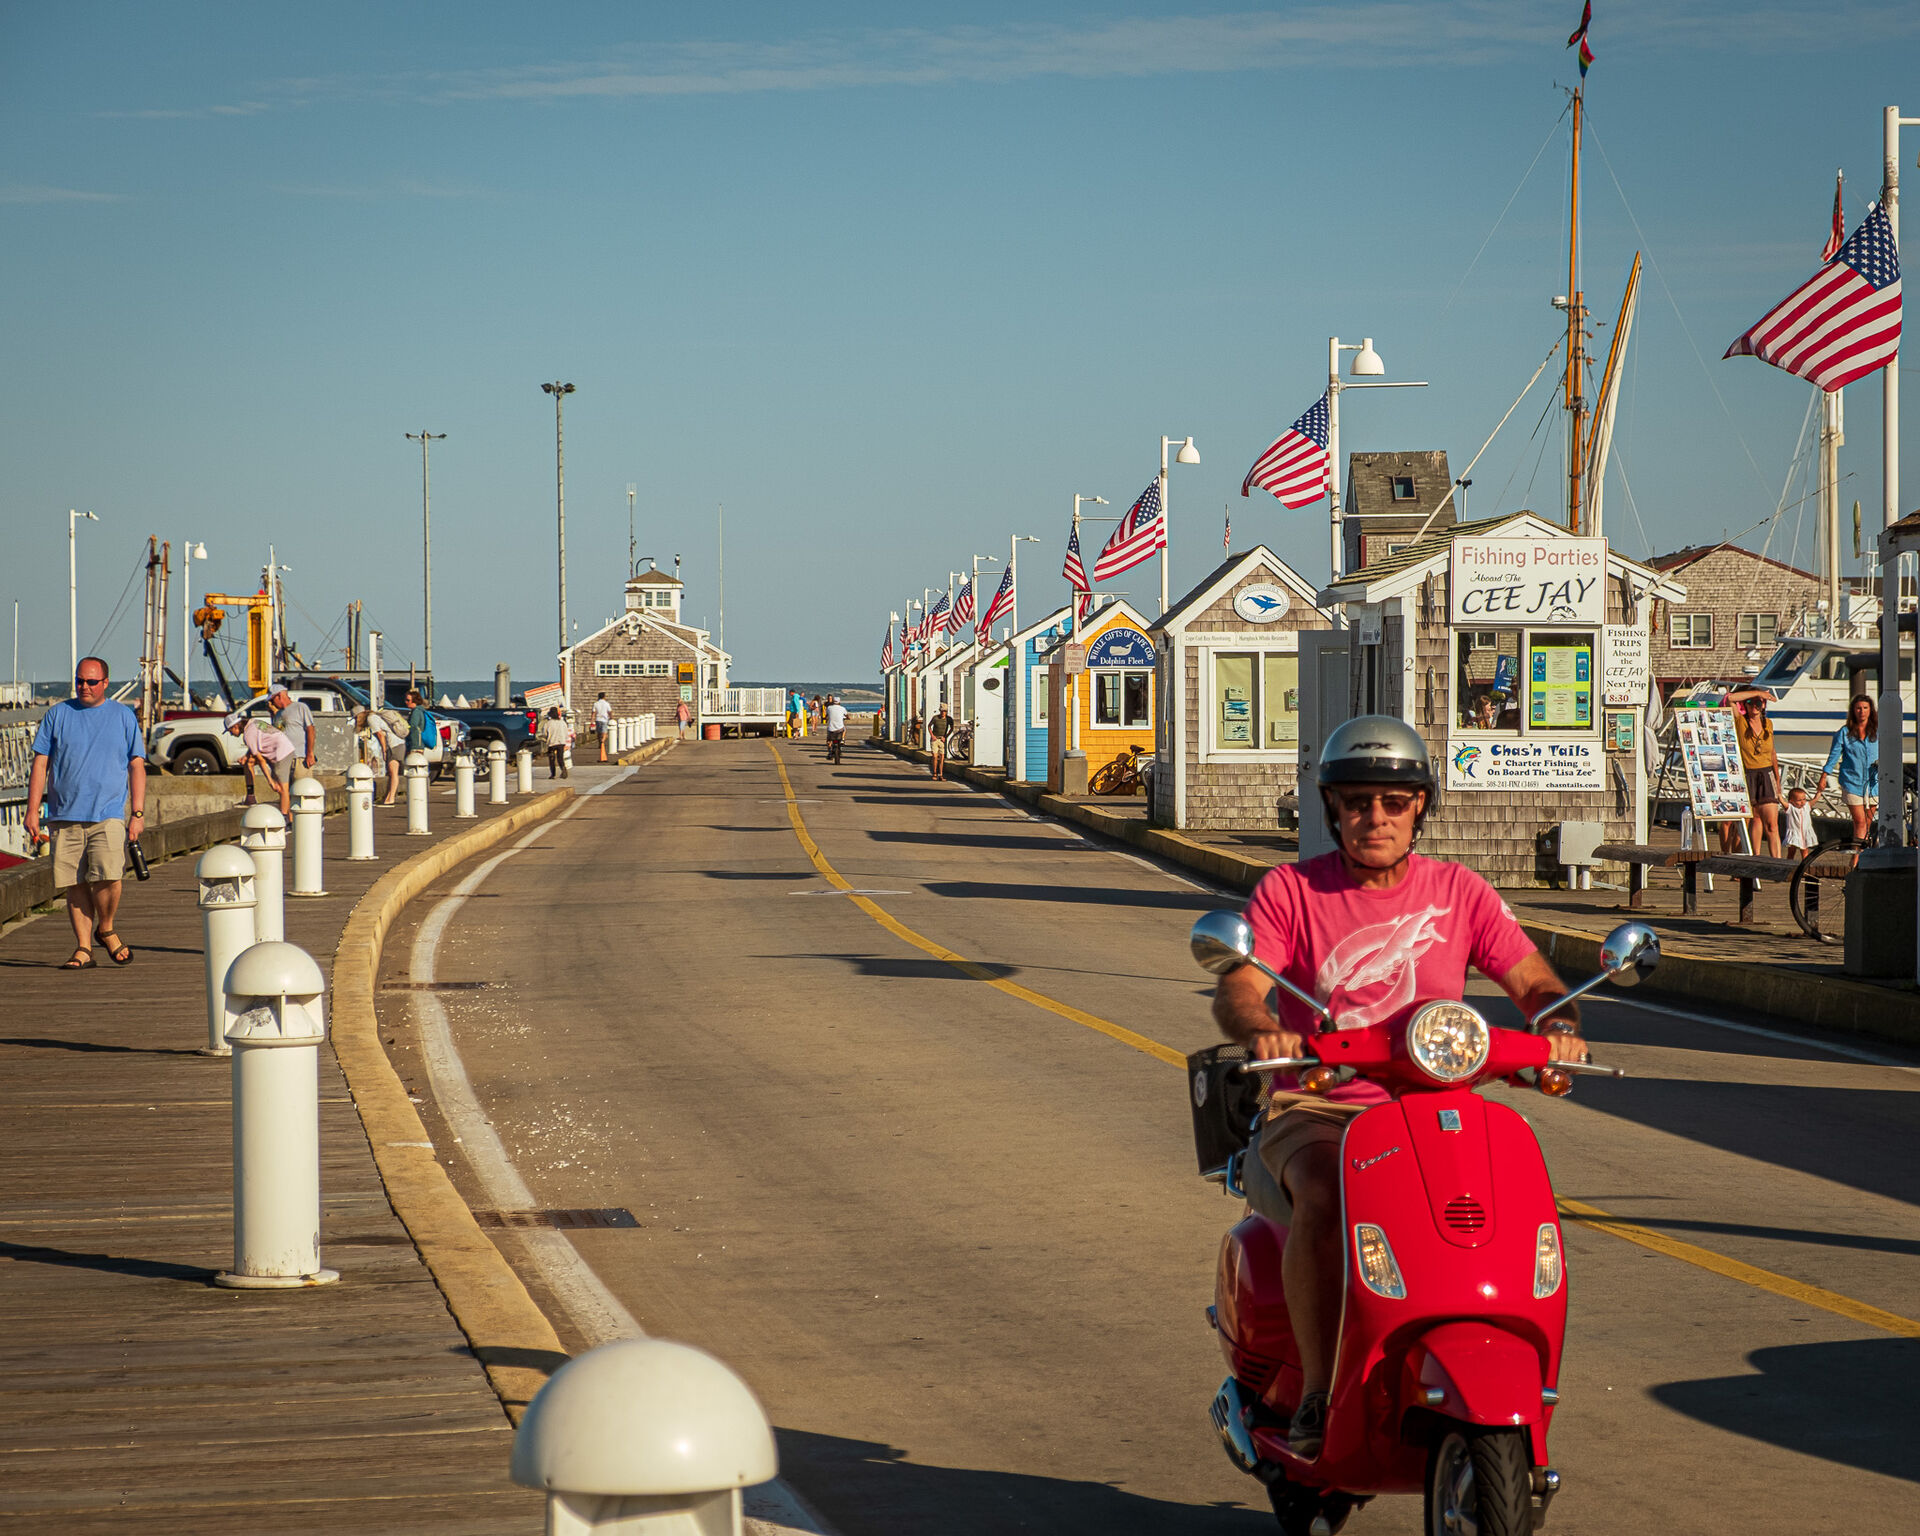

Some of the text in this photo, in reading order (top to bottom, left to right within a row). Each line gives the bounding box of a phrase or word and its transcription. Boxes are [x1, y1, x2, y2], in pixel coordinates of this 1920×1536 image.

[1462, 546, 1599, 568] Fishing Parties
[1470, 573, 1522, 582] Aboard The
[1462, 577, 1597, 615] CEE JAY
[1607, 629, 1647, 637] FISHING
[1090, 630, 1154, 660] WHALE GIFTS OF CAPE COD
[1612, 639, 1642, 647] TRIPS
[1612, 649, 1641, 657] Aboard
[1100, 656, 1144, 666] Dolphin Fleet
[1404, 656, 1415, 672] 2
[1606, 667, 1647, 678] CEE JAY
[1606, 680, 1647, 690] Next Trip
[1609, 694, 1629, 702] 8:30
[1490, 743, 1590, 756] Chas'n Tails
[1505, 759, 1578, 768] Charter Fishing
[1487, 768, 1500, 776] On
[1502, 768, 1530, 776] Board
[1532, 768, 1550, 776] The
